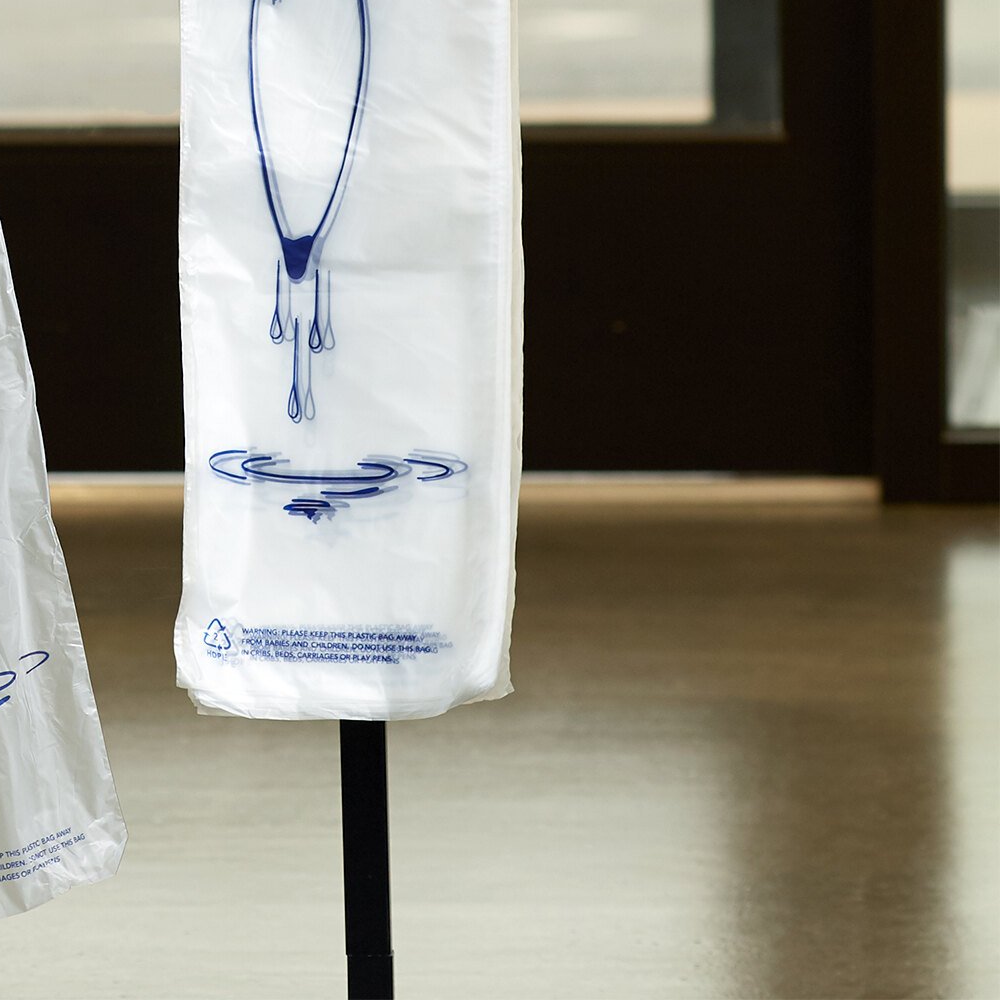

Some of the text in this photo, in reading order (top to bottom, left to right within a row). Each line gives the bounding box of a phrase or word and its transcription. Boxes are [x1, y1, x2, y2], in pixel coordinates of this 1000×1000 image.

[242, 627, 280, 637] WARNING:
[281, 629, 308, 638] PLEASE
[309, 630, 329, 638] KEEP
[330, 631, 346, 639] THIS
[348, 632, 377, 641] PLASTIC
[378, 633, 395, 641] BAG
[241, 638, 263, 646] FROM
[265, 639, 290, 647] BABIES
[291, 640, 309, 648] AND
[351, 643, 364, 651] DO
[398, 645, 414, 653] THIS
[275, 651, 296, 659] BEDS,
[297, 651, 339, 660] CARRIAGES
[339, 653, 351, 661] OR
[352, 653, 371, 661] PLAY
[5, 849, 21, 860] THIS
[41, 833, 56, 845] BAG
[56, 827, 72, 839] AWAY
[48, 843, 61, 855] USE
[74, 832, 86, 844] BAG
[20, 869, 31, 878] OR
